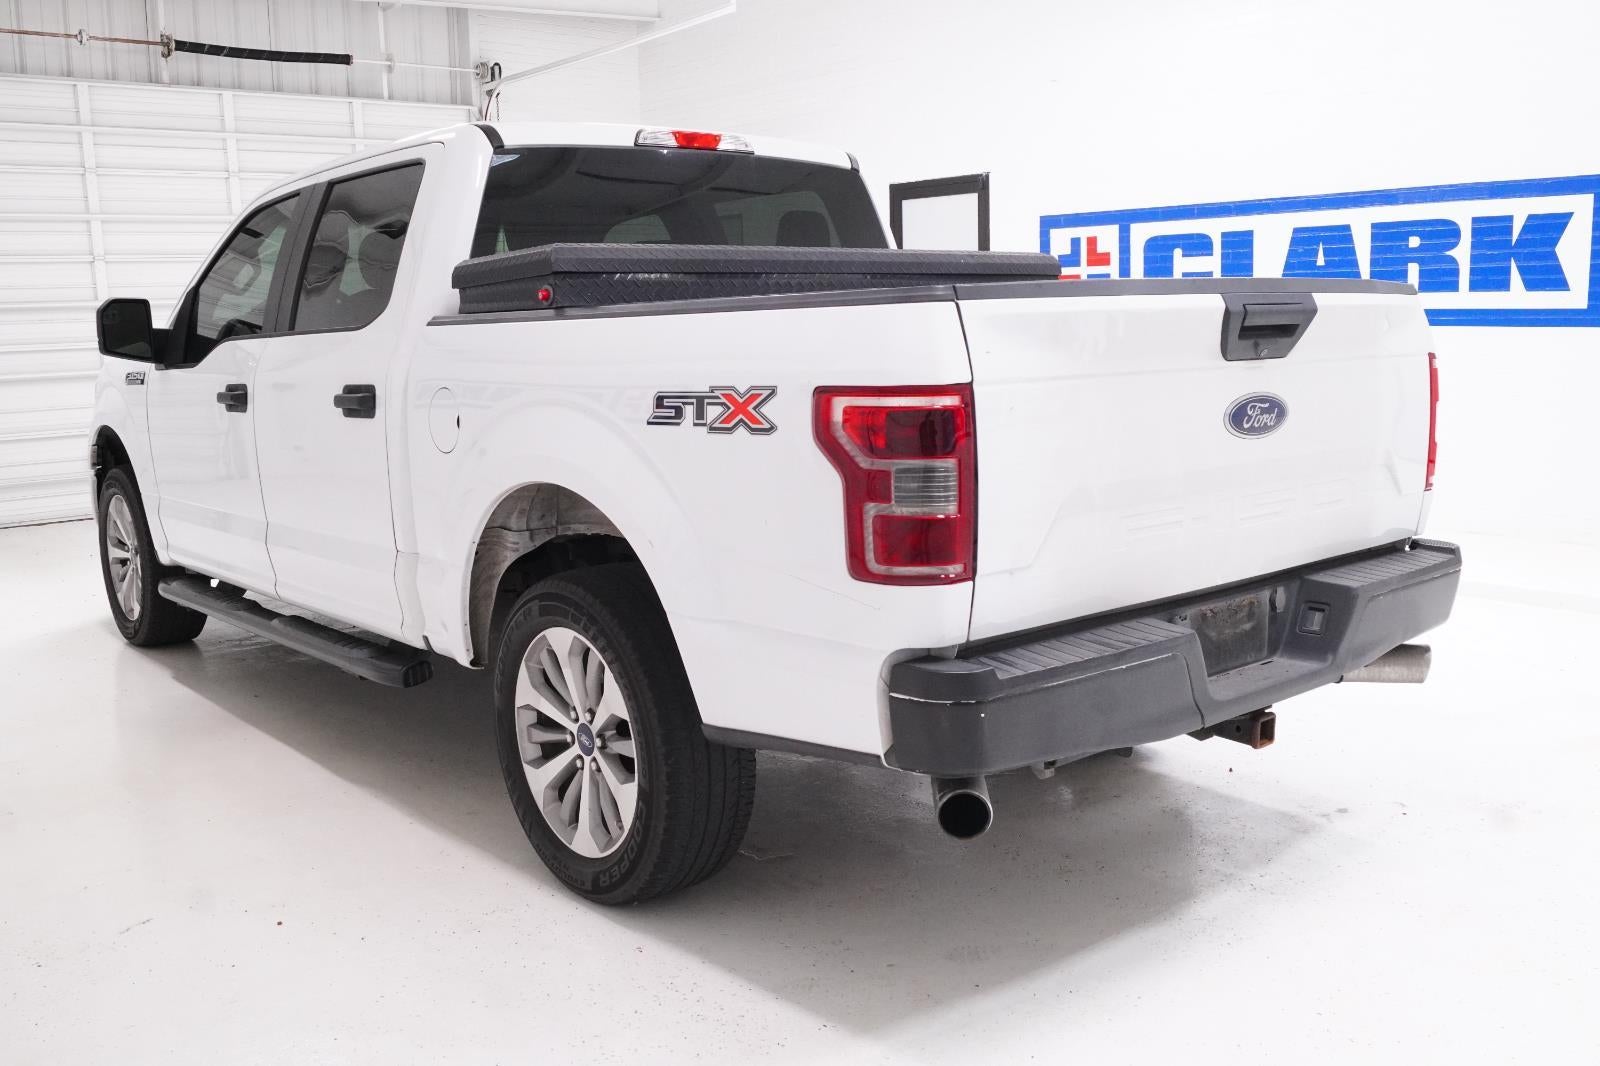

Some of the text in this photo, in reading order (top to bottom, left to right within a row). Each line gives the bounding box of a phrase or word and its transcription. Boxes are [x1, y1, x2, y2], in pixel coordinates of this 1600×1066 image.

[1143, 211, 1575, 292] CLARK
[647, 386, 777, 435] STX
[1243, 402, 1278, 429] Ford
[599, 799, 646, 887] COOPER
